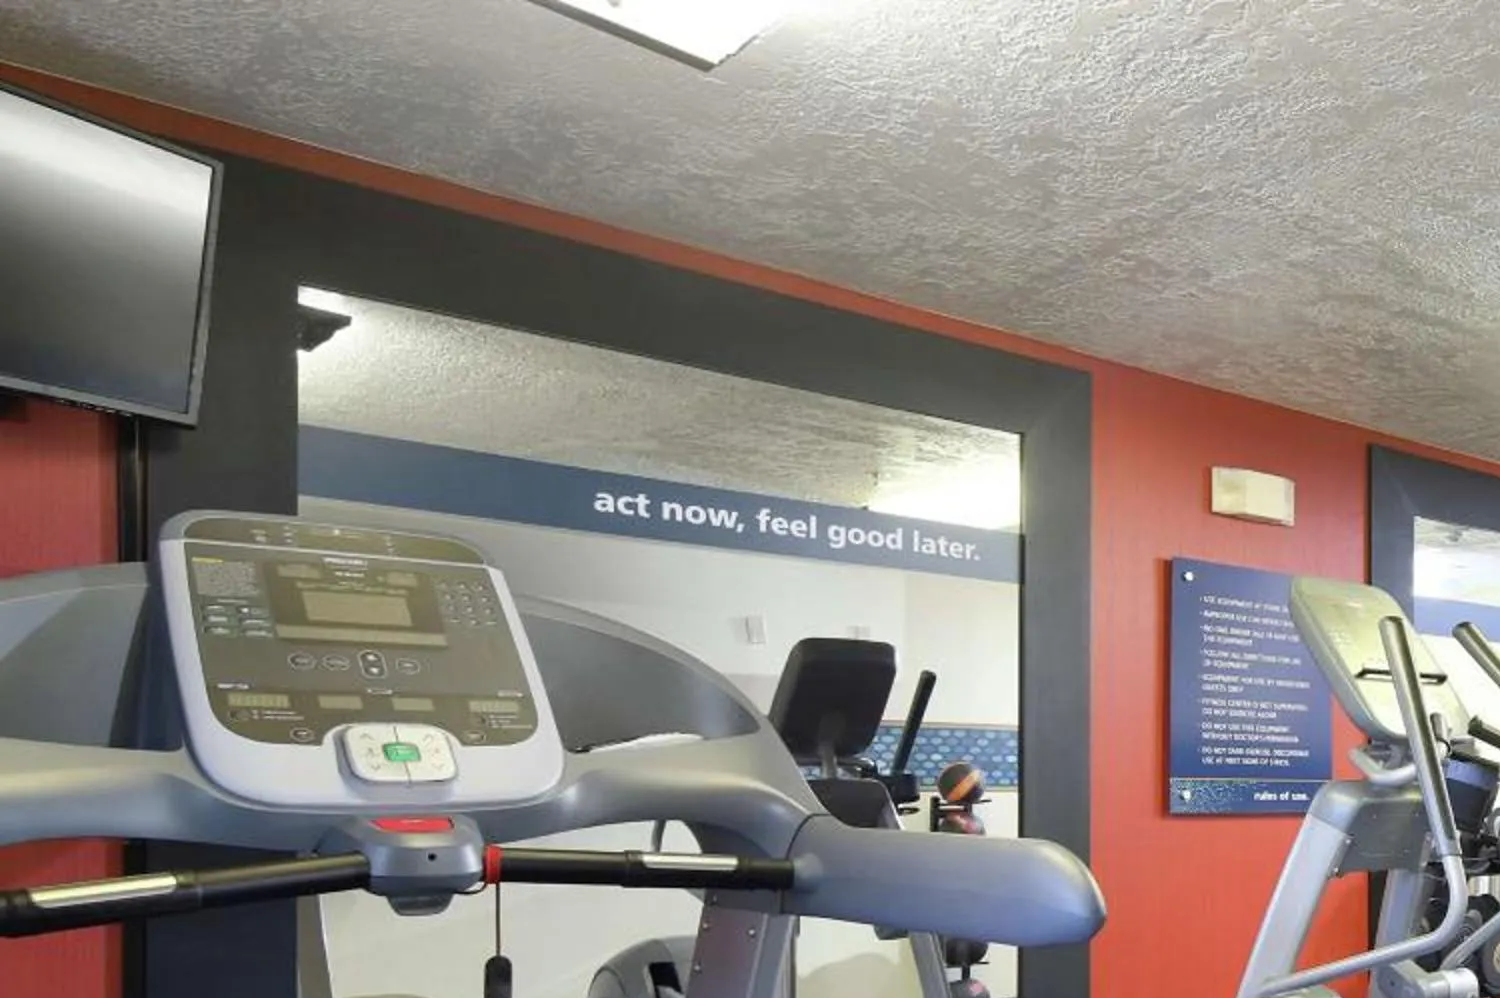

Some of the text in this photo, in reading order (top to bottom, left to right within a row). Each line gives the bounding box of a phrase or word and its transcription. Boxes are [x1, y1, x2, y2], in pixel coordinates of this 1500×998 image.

[594, 491, 980, 561] act now, feel good later.
